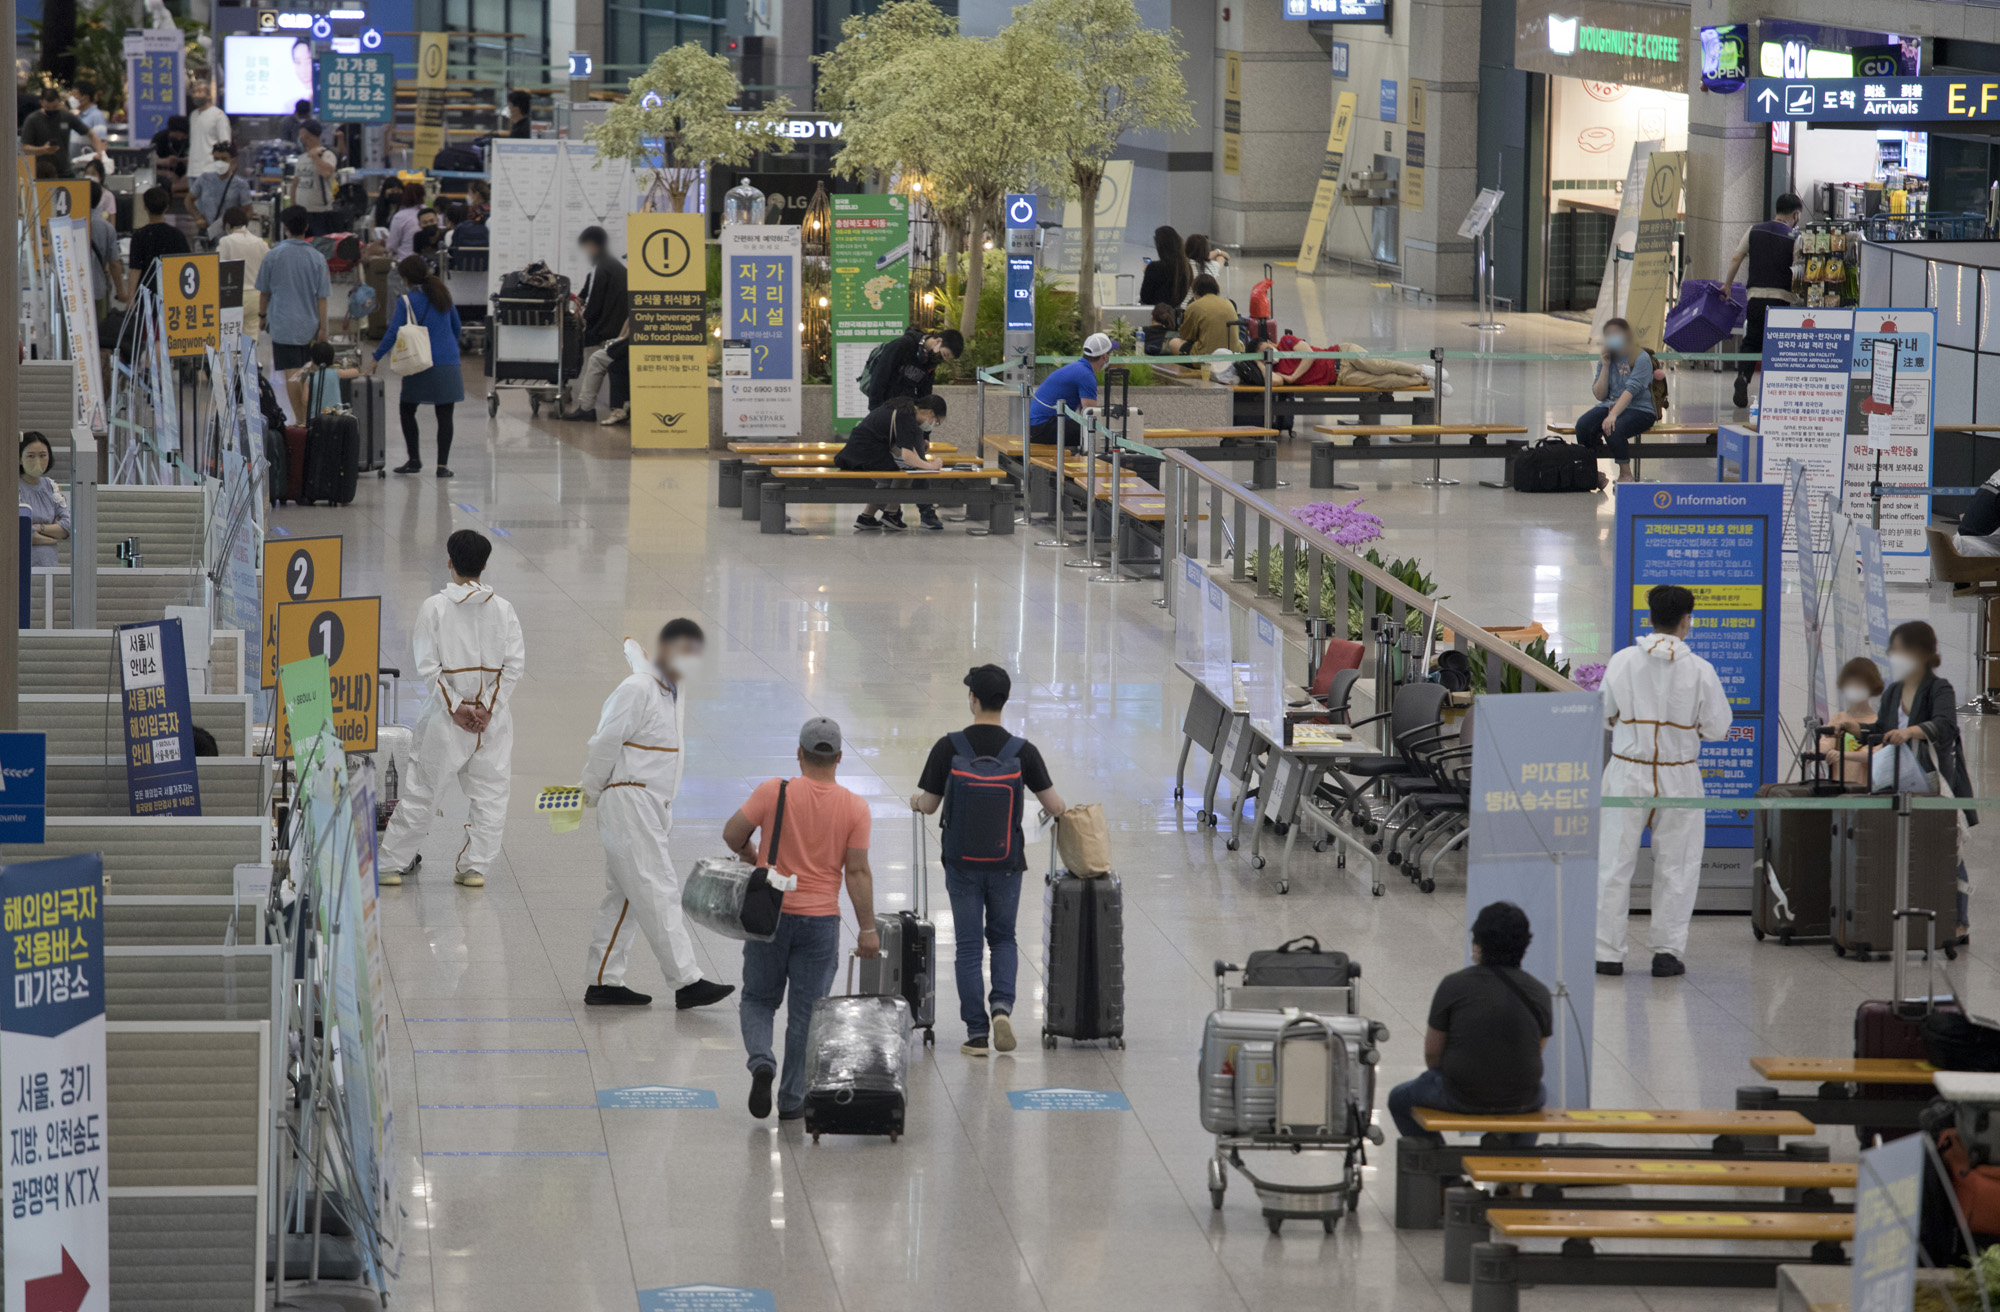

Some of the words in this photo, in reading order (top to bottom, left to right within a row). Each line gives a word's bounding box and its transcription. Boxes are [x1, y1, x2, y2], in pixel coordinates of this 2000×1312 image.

[1579, 25, 1634, 57] DOUGHNUTS
[1636, 32, 1643, 57] &
[1645, 34, 1678, 62] COFFEE
[335, 58, 378, 72] 자가용
[1784, 40, 1807, 78] CU
[1706, 65, 1746, 79] OPEN
[1864, 62, 1890, 77] CU
[328, 72, 386, 87] 이용고객
[328, 88, 386, 102] 대기장소
[1593, 81, 1624, 95] NOW
[1823, 90, 1857, 109] 도착
[1864, 101, 1919, 115] Arrivals
[816, 121, 843, 138] TV
[1772, 121, 1790, 145] SIM
[787, 196, 808, 209] LG
[835, 219, 870, 228] 충청북도로
[184, 267, 197, 295] 3
[634, 294, 661, 305] 음식물
[663, 294, 701, 305] 취식불가
[167, 303, 215, 331] 강원도
[635, 313, 655, 322] Only
[656, 313, 701, 323] beverages
[660, 323, 692, 331] allowed
[167, 332, 216, 353] Gangwon-do
[633, 333, 649, 342] (No
[651, 333, 671, 341] food
[672, 333, 703, 342] please)
[1825, 342, 1838, 350] 안내
[754, 345, 769, 372] ?
[1903, 357, 1925, 368] 注意
[1853, 445, 1874, 456] 여권과
[1896, 464, 1924, 472] 보여주세요
[1676, 494, 1747, 505] Information
[1644, 524, 1705, 535] 고객안내근무자
[1707, 524, 1725, 534] 보호
[1727, 524, 1753, 535] 안내문
[1716, 549, 1731, 558] 부터
[1644, 560, 1695, 568] 고객안내근무자를
[1697, 560, 1723, 568] 보호하고
[293, 556, 308, 595] 2
[1721, 618, 1755, 628] 시행안내
[130, 632, 155, 653] 서울시
[319, 619, 332, 659] 1
[130, 657, 156, 677] 안내소
[128, 686, 166, 712] 서울지역
[129, 711, 180, 739] 해외입국자
[131, 743, 152, 767] 안내
[154, 748, 181, 760] 서울특별시
[1730, 748, 1744, 756] 안내
[1739, 759, 1754, 768] 위한
[134, 790, 144, 800] 모든
[144, 787, 163, 798] 해외입국
[163, 783, 194, 796] 서울거주자는
[178, 796, 196, 807] 14일간
[1711, 862, 1741, 870] Airport
[3, 885, 98, 932] 해외입국자
[13, 927, 89, 970] 전용버스
[14, 964, 89, 1009] 대기장소
[60, 1064, 92, 1106] 경기
[46, 1113, 101, 1161] 인천송도
[11, 1170, 60, 1220] 광명역
[64, 1166, 101, 1209] KTX
